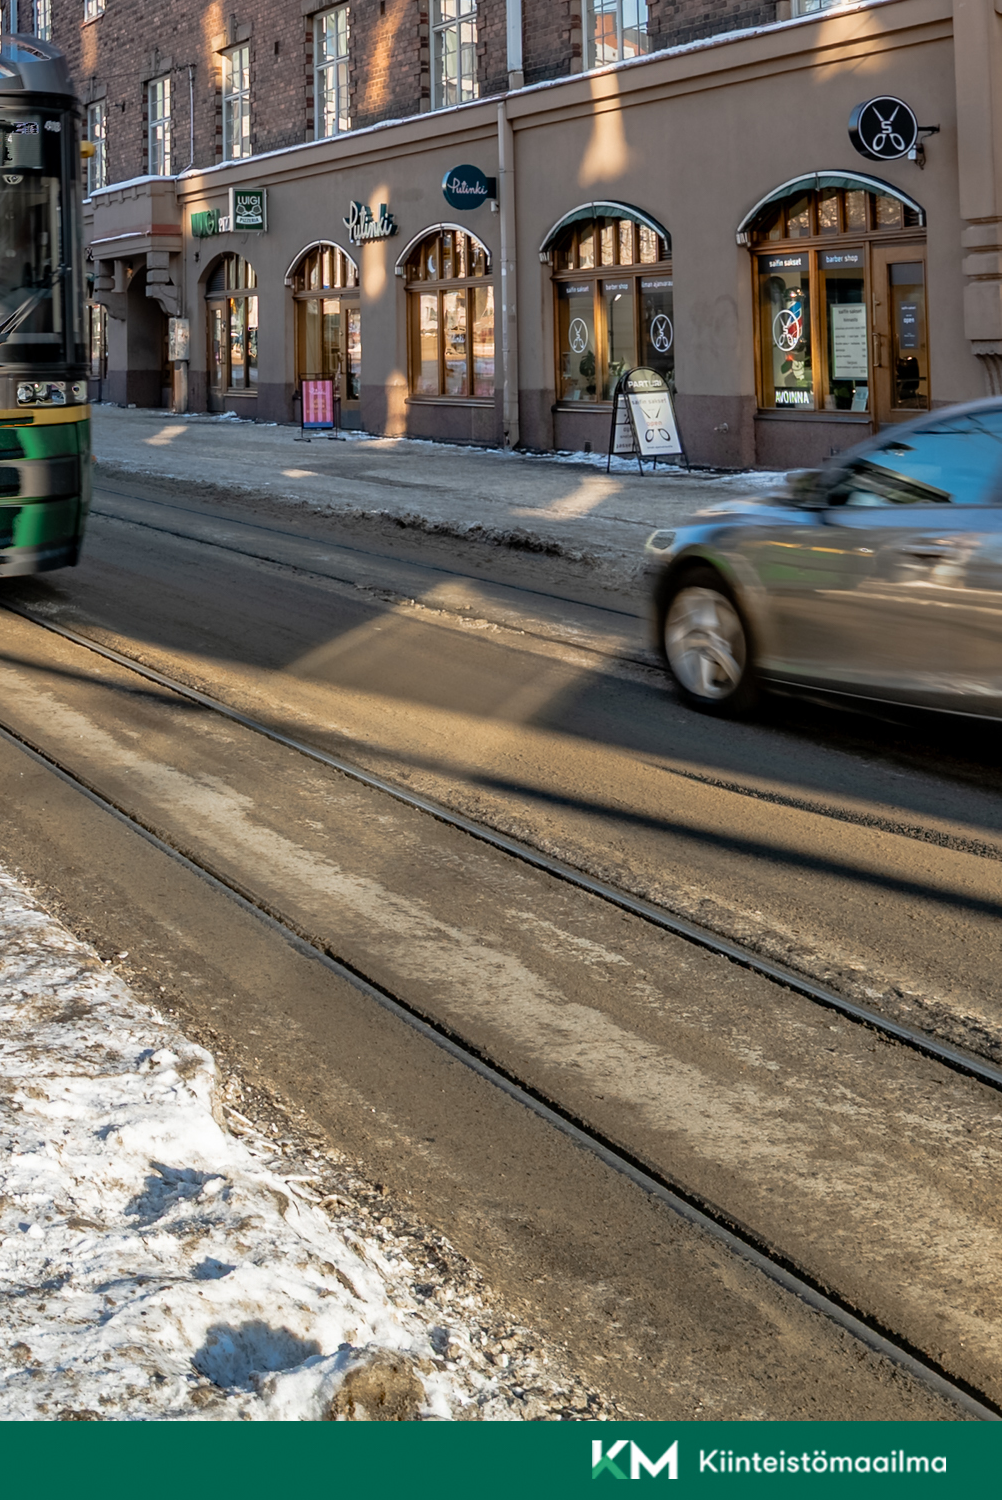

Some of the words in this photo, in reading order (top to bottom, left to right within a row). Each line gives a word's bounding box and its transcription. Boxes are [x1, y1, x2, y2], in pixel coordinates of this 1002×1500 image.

[447, 177, 488, 195] Putinki
[237, 196, 261, 205] LUIGI
[342, 200, 396, 243] Putinki
[784, 258, 802, 266] sakset
[826, 255, 843, 263] barber
[844, 254, 858, 262] shop
[627, 380, 662, 388] PARTURI
[775, 390, 809, 404] AVOINNA
